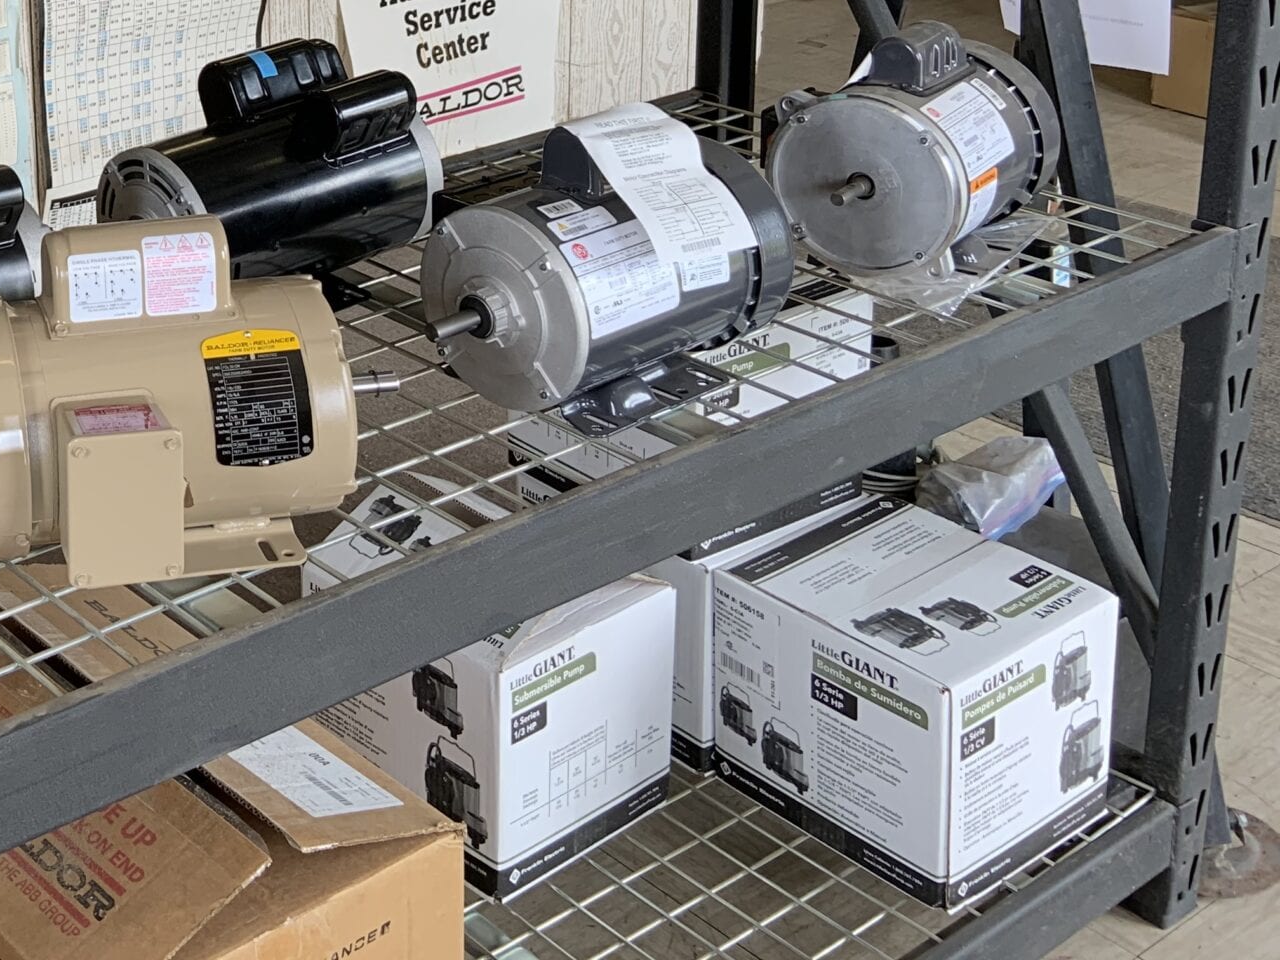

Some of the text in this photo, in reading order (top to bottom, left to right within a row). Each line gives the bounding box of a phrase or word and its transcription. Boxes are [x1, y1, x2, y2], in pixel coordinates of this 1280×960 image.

[416, 31, 490, 68] Center
[420, 74, 525, 121] ALDOR
[206, 342, 248, 351] BALDOR
[704, 333, 770, 366] Little GIANT
[732, 360, 754, 373] Pump
[720, 399, 730, 407] HP
[521, 486, 543, 503] Little
[716, 587, 732, 601] TEM
[1002, 578, 1066, 614] Submersible Pump
[1036, 585, 1087, 619] Little GIANT
[83, 599, 167, 657] BALD
[510, 645, 576, 691] Little GIANT
[811, 638, 899, 690] Little GIANT
[514, 663, 585, 706] Submersible Pump
[814, 679, 821, 687] 6
[814, 689, 844, 710] 1/3 HP
[816, 659, 922, 720] Bomba de Sumidero
[960, 659, 1024, 707] Little GIANT
[964, 672, 1035, 721] Pompes de Puisard
[513, 710, 541, 728] 6 Series
[514, 721, 538, 740] 1/3 HP
[963, 737, 969, 745] 6
[963, 737, 986, 756] 1/3 CV
[121, 817, 157, 846] UP
[87, 830, 145, 883] ON END
[21, 838, 116, 922] LDOR
[20, 879, 42, 902] ABB
[38, 899, 81, 937] GROUP
